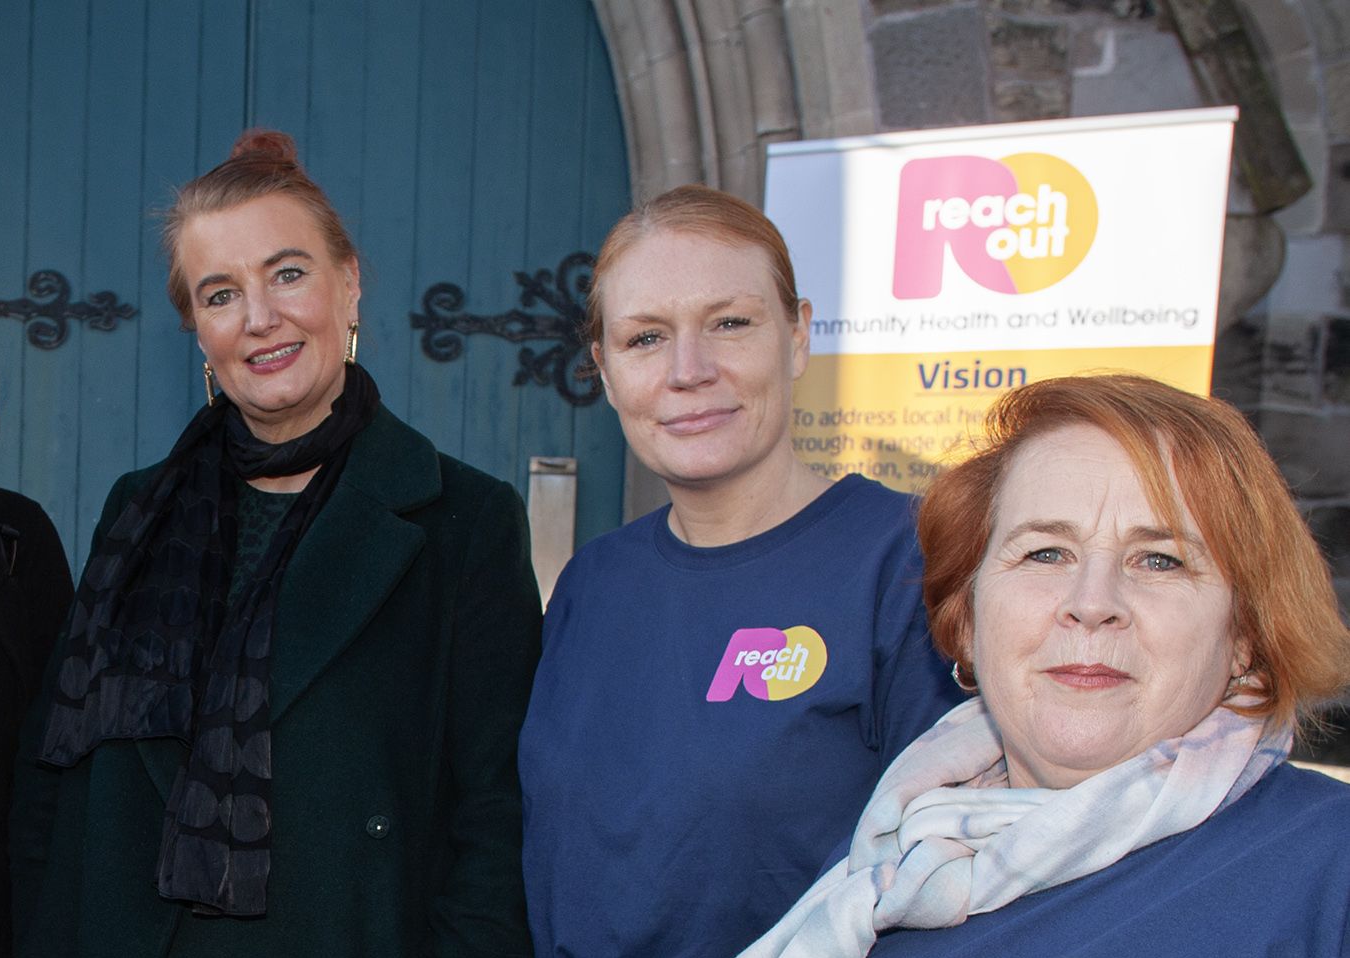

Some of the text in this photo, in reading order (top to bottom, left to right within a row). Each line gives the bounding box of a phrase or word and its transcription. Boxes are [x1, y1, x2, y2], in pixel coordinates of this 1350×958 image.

[922, 184, 1068, 231] reach
[985, 226, 1070, 261] out
[810, 303, 1199, 337] mmunity Health and Wellbeing
[917, 359, 1028, 390] Vision
[818, 406, 896, 427] address
[903, 404, 951, 425] local
[734, 643, 809, 666] reach
[760, 664, 806, 682] out
